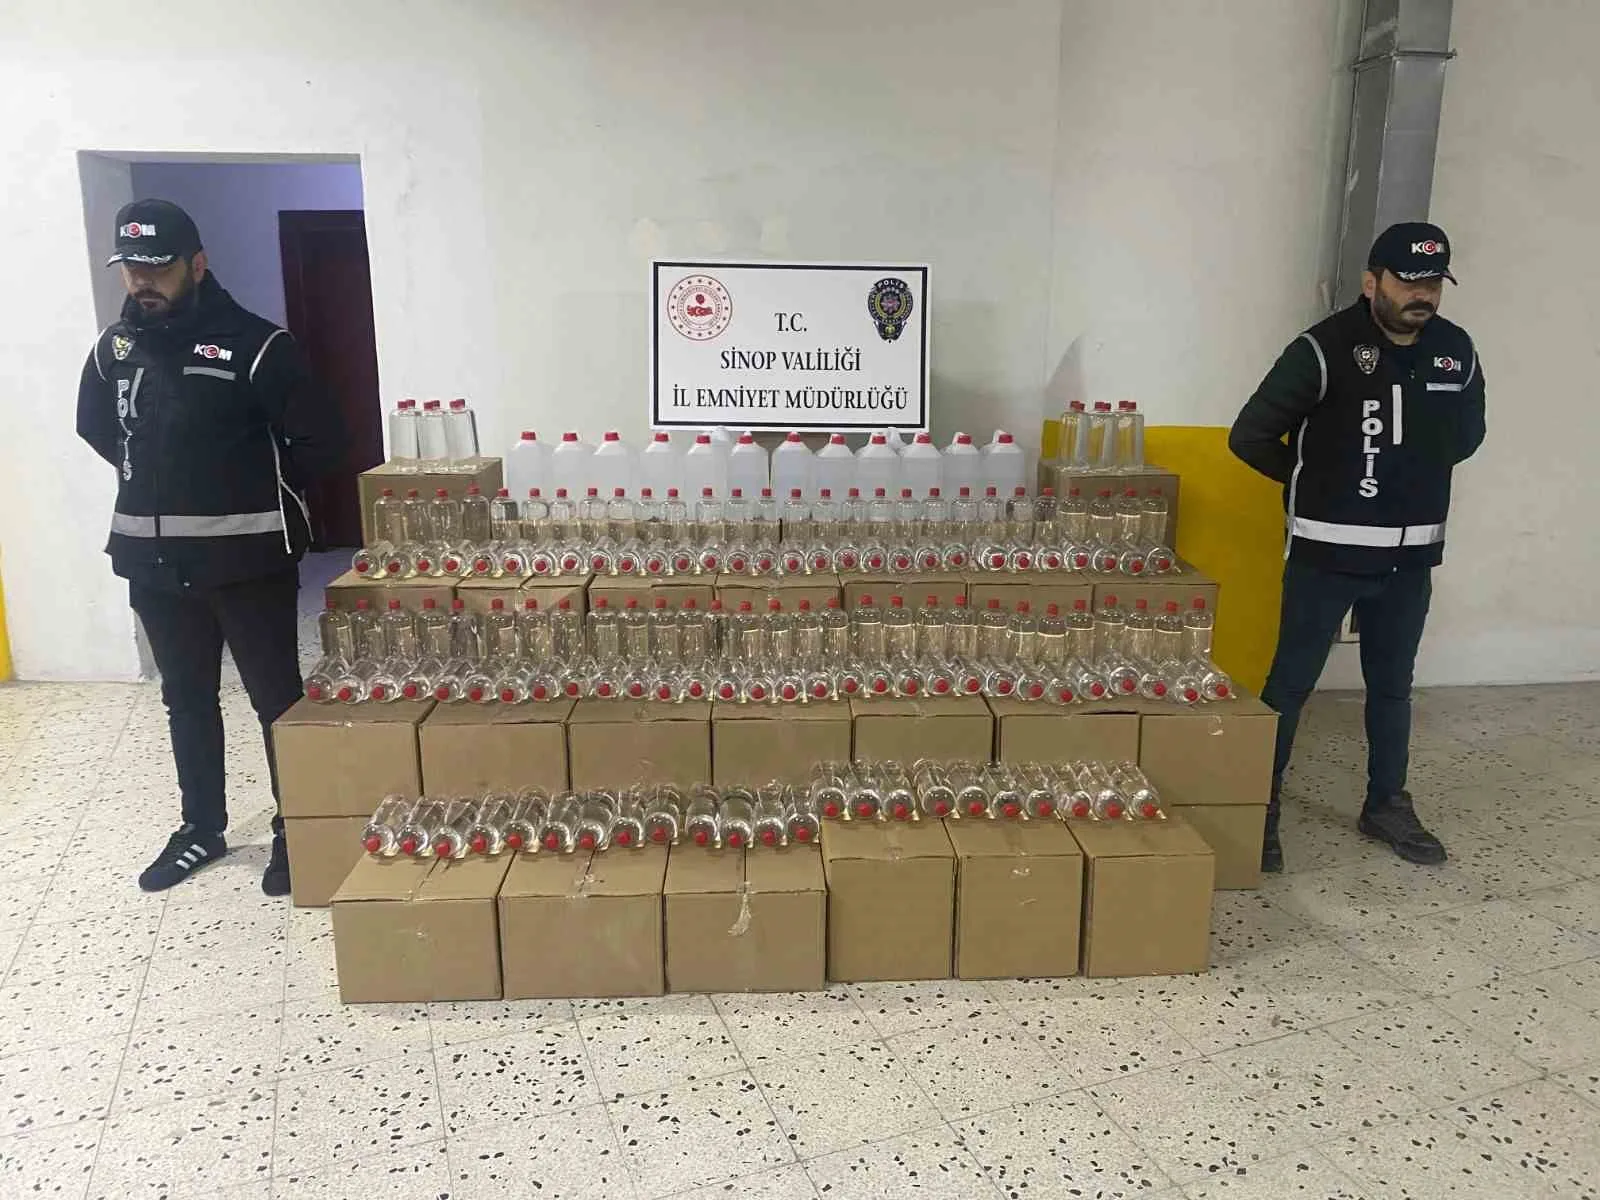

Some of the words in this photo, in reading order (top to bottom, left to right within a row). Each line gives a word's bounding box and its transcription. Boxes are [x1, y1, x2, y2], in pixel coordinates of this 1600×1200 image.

[774, 313, 807, 332] T.C.
[193, 343, 232, 361] KOM
[720, 347, 777, 370] SİNOP
[782, 346, 861, 371] VALİLİĞİ
[672, 384, 690, 407] İL
[696, 385, 781, 408] EMNİYET
[785, 385, 908, 410] MÜDÜRLÜĞÜ
